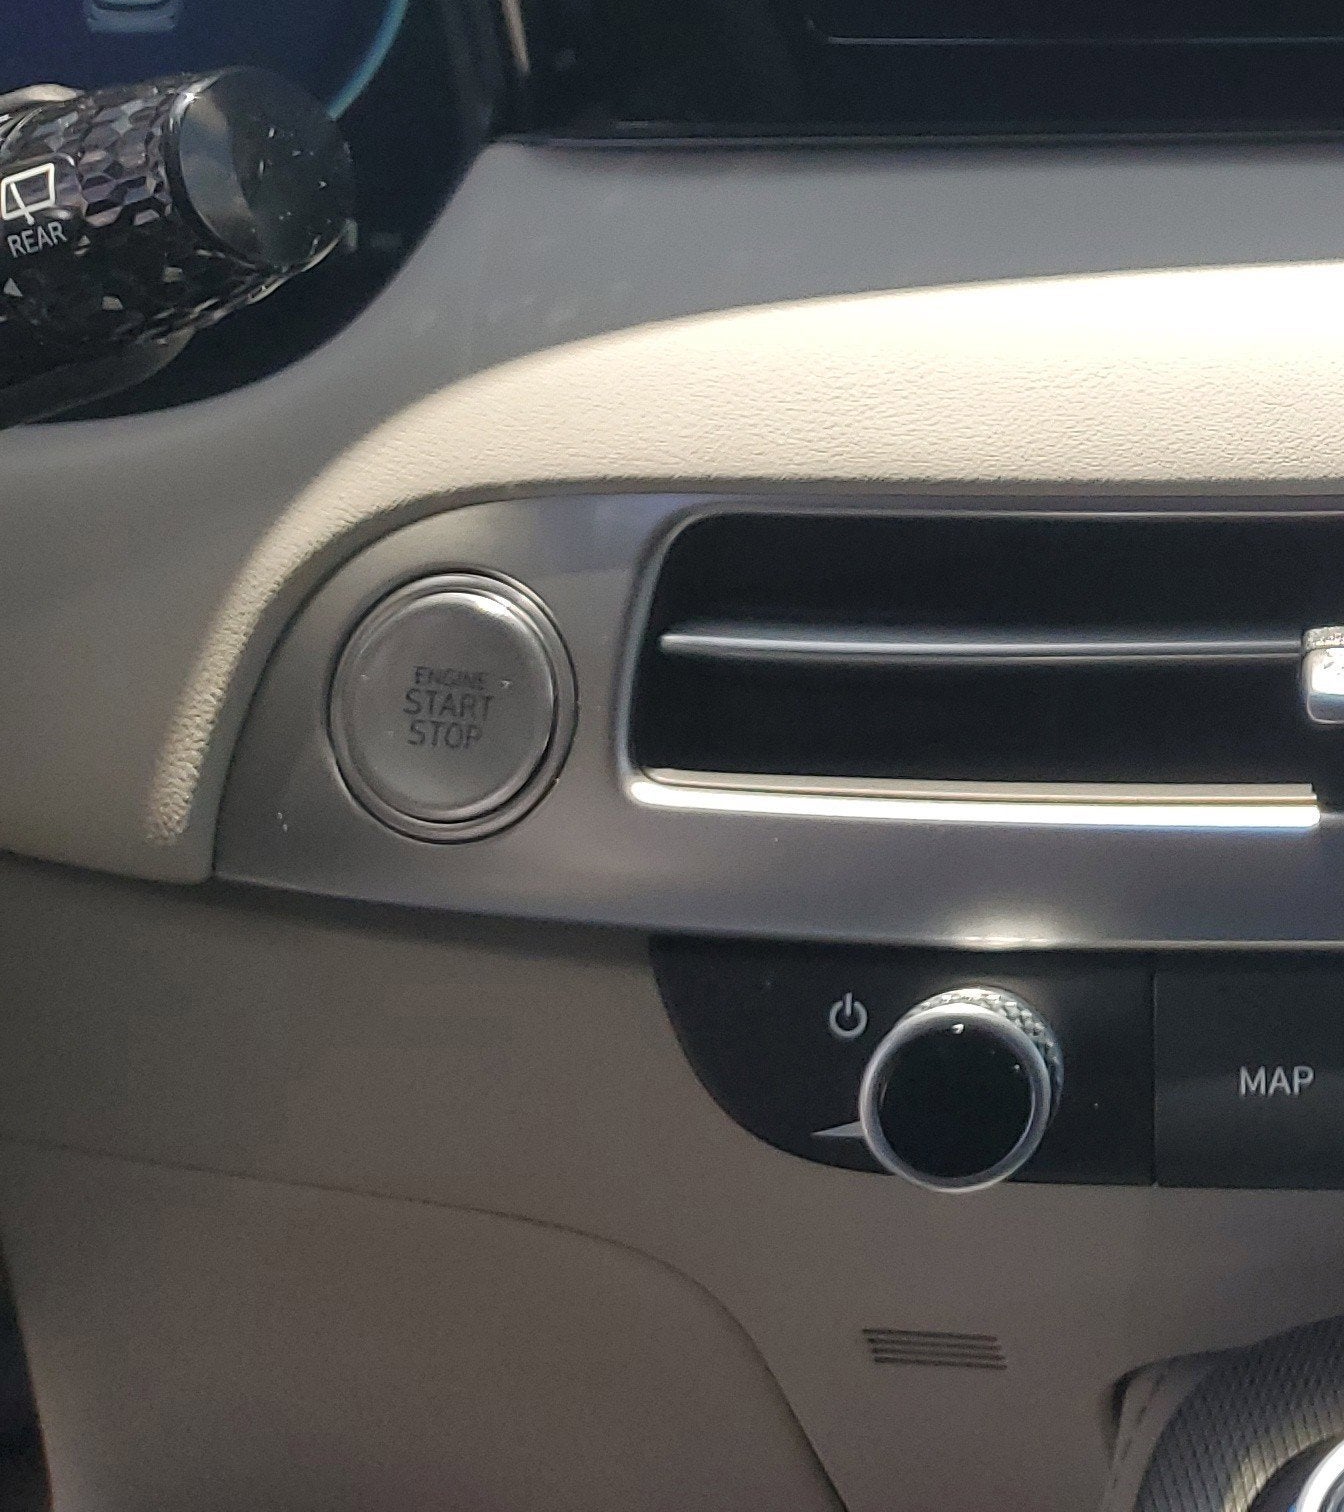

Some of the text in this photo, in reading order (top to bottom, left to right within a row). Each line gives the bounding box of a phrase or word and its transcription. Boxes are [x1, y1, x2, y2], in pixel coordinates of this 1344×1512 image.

[7, 221, 68, 259] REAR
[403, 687, 495, 721] START
[407, 718, 483, 749] STOP
[1238, 1065, 1315, 1098] MAP
